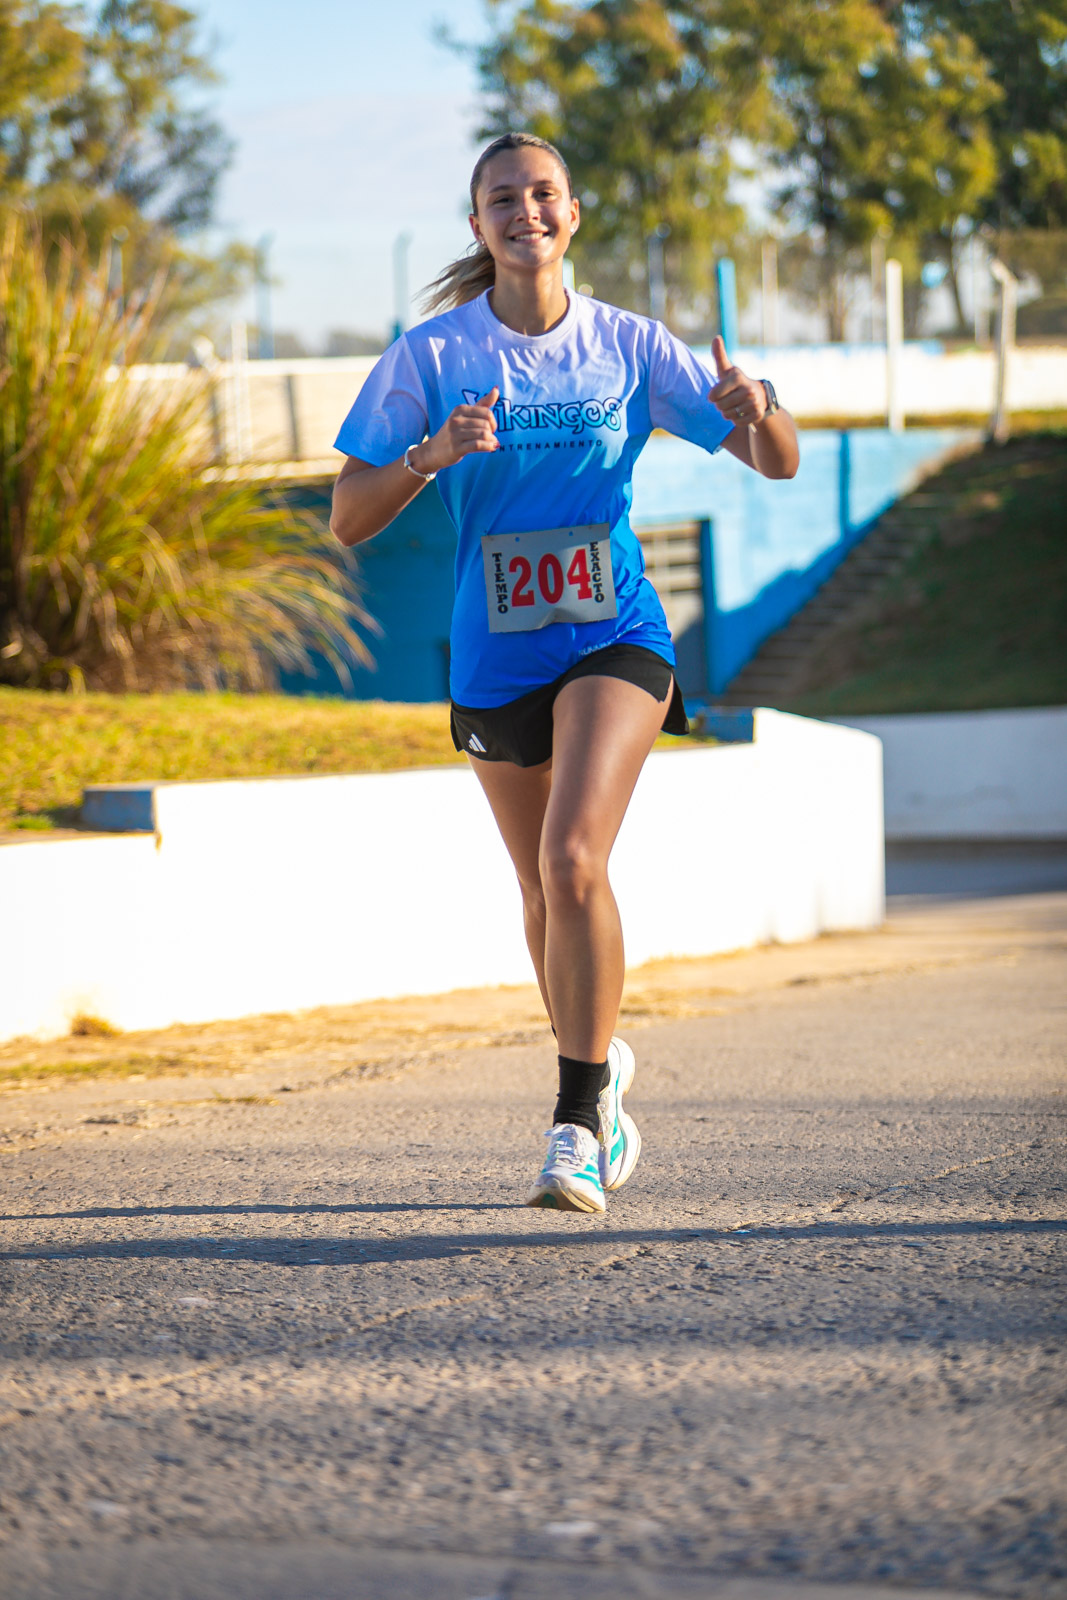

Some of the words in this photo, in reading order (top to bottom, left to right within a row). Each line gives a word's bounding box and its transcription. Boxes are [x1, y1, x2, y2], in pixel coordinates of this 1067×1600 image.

[499, 439, 603, 452] NTRENAMIENTO
[492, 552, 508, 614] TIEMPO
[509, 548, 592, 608] 204
[590, 541, 605, 603] EXACTO
